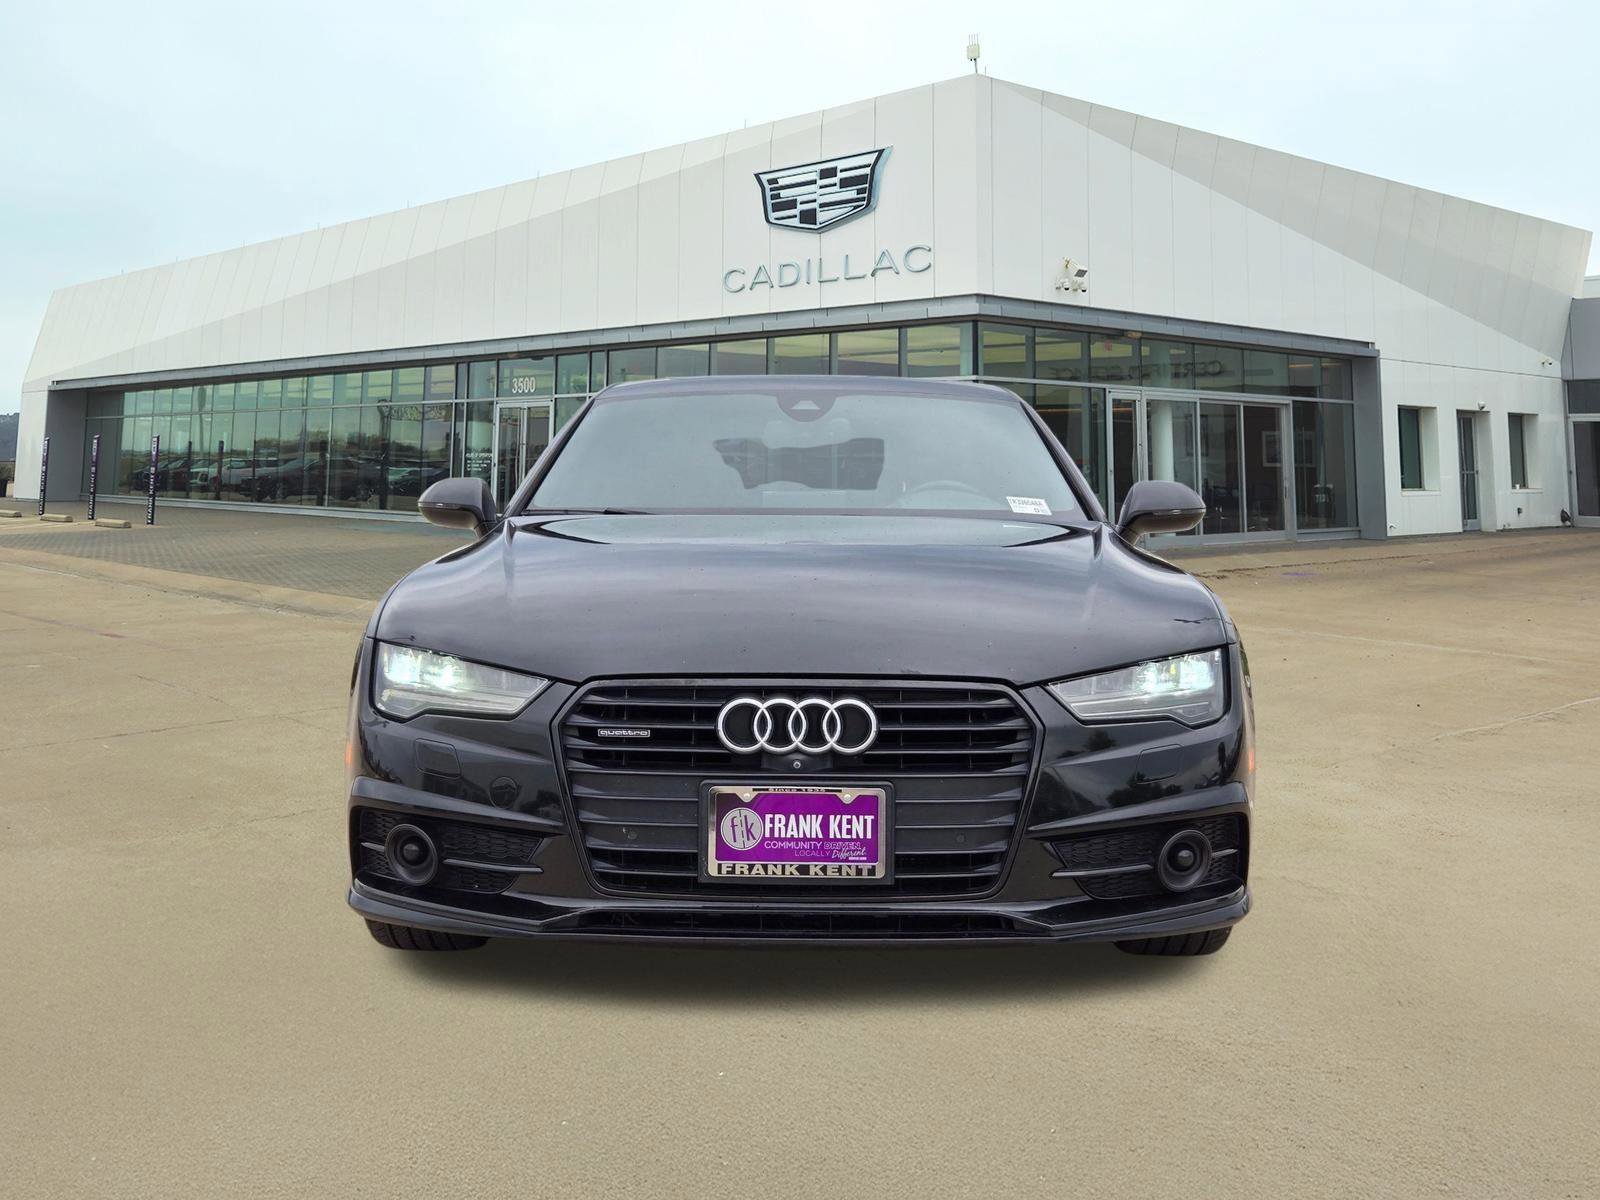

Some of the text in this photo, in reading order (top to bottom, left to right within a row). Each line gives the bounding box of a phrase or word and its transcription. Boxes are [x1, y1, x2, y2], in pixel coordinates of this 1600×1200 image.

[724, 244, 932, 293] CADILLAC
[511, 377, 536, 393] 3500
[764, 813, 875, 839] FRANK KENT
[764, 841, 822, 850] COMMUNITY
[721, 863, 873, 876] FRANK KENT
